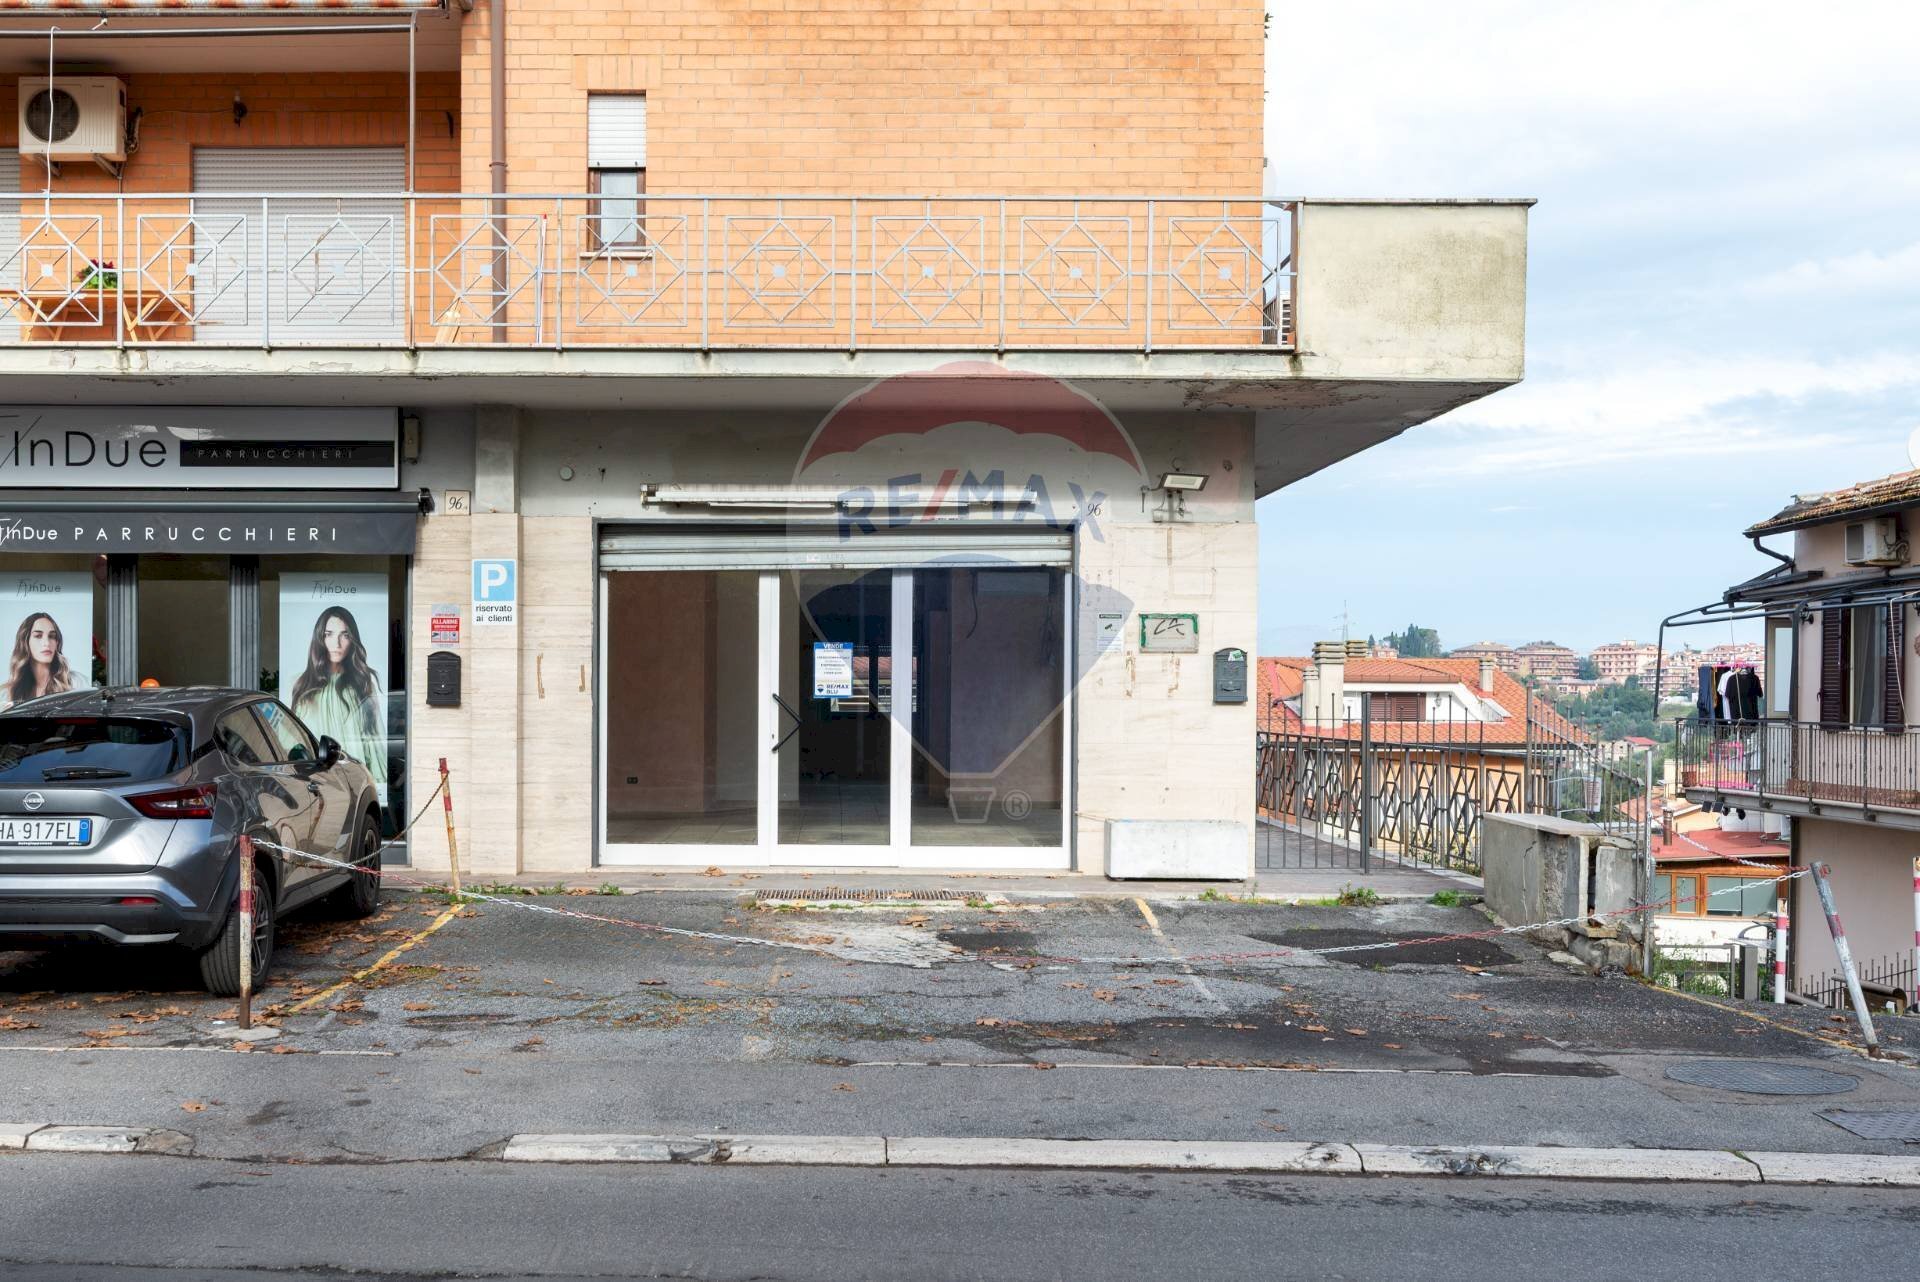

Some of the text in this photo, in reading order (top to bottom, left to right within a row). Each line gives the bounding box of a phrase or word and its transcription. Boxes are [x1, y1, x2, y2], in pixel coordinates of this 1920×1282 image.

[197, 449, 353, 459] PARRUCCHIERI
[448, 496, 463, 510] 96
[1086, 503, 1102, 516] 96
[74, 527, 336, 541] PARRUCCHIERI
[480, 563, 508, 599] P
[475, 604, 513, 612] riservato
[23, 822, 76, 840] 917FL
